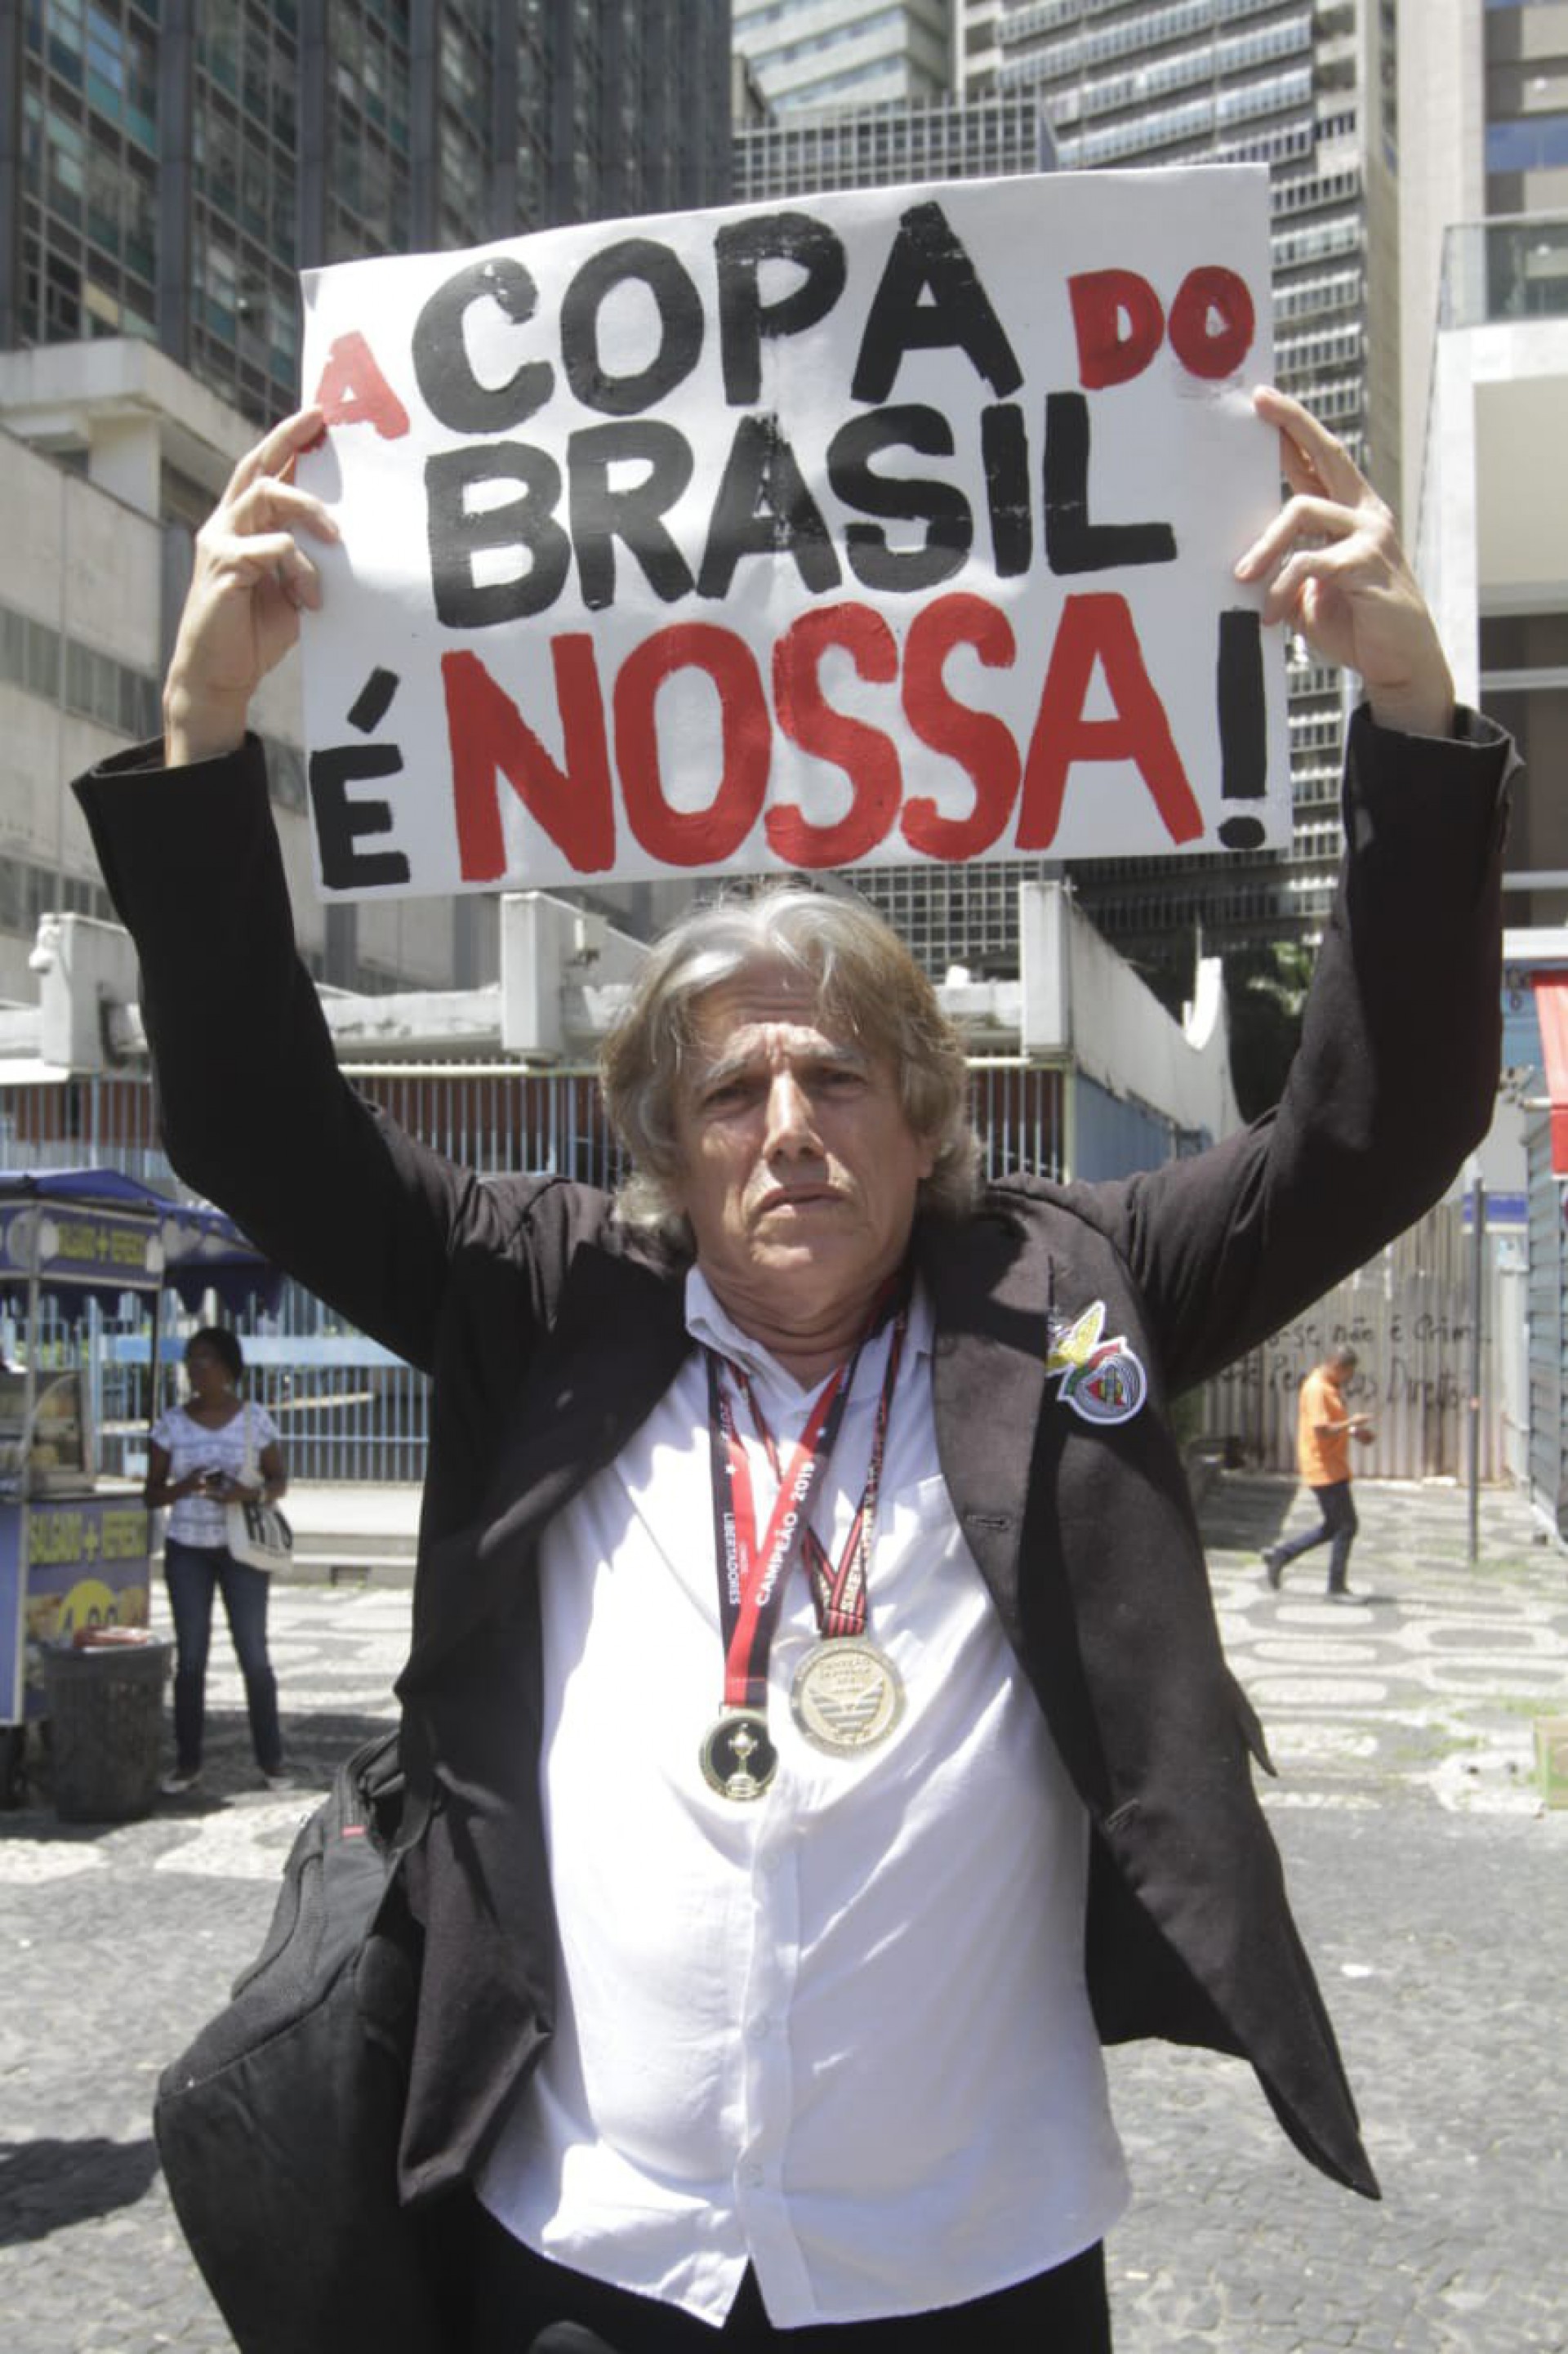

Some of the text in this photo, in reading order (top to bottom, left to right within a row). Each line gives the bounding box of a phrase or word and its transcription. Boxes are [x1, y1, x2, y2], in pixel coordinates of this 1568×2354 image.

[312, 201, 1255, 452] A COPA DO
[423, 392, 1178, 628] BRASIL
[308, 667, 411, 891] É
[724, 1512, 741, 1605] LIBERTADORES
[755, 1460, 816, 1607] CAMPEÃO 2019
